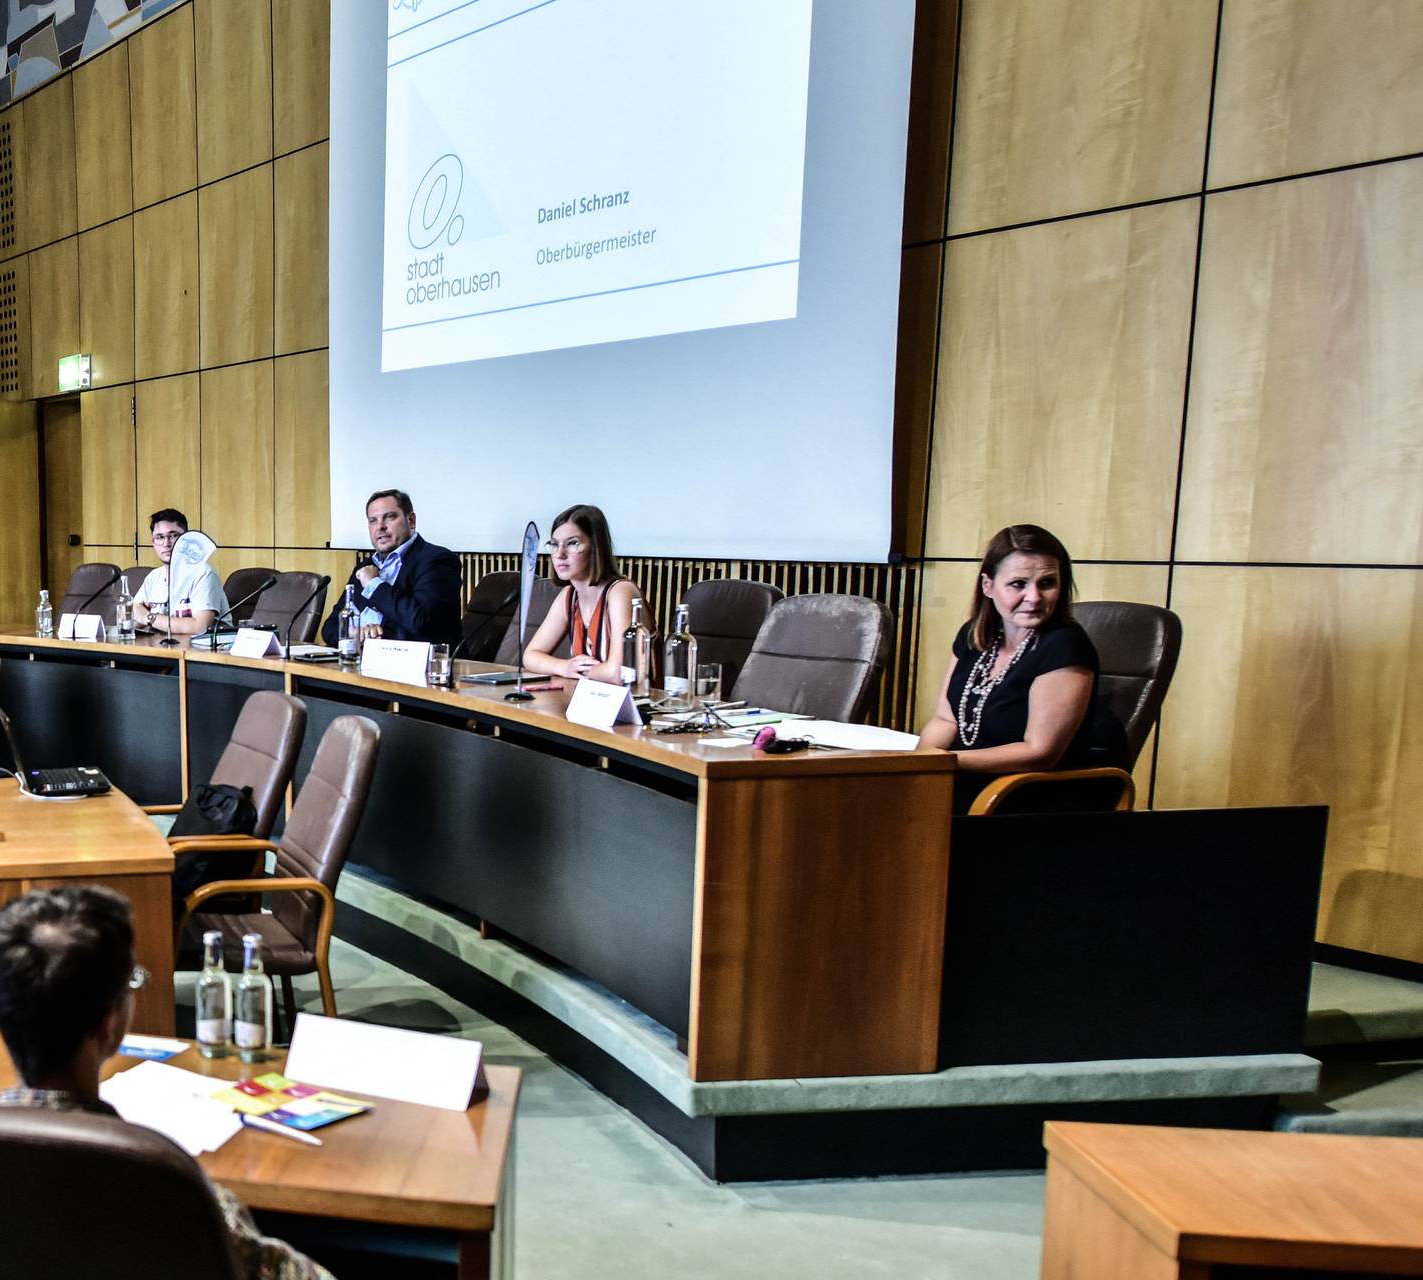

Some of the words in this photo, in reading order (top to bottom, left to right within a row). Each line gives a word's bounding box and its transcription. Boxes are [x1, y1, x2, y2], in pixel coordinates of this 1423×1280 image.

[538, 199, 576, 224] Daniel
[579, 190, 630, 214] Schranz
[536, 229, 657, 265] Oberbürgermeister
[407, 252, 444, 281] stadt
[406, 270, 500, 305] oberhausen
